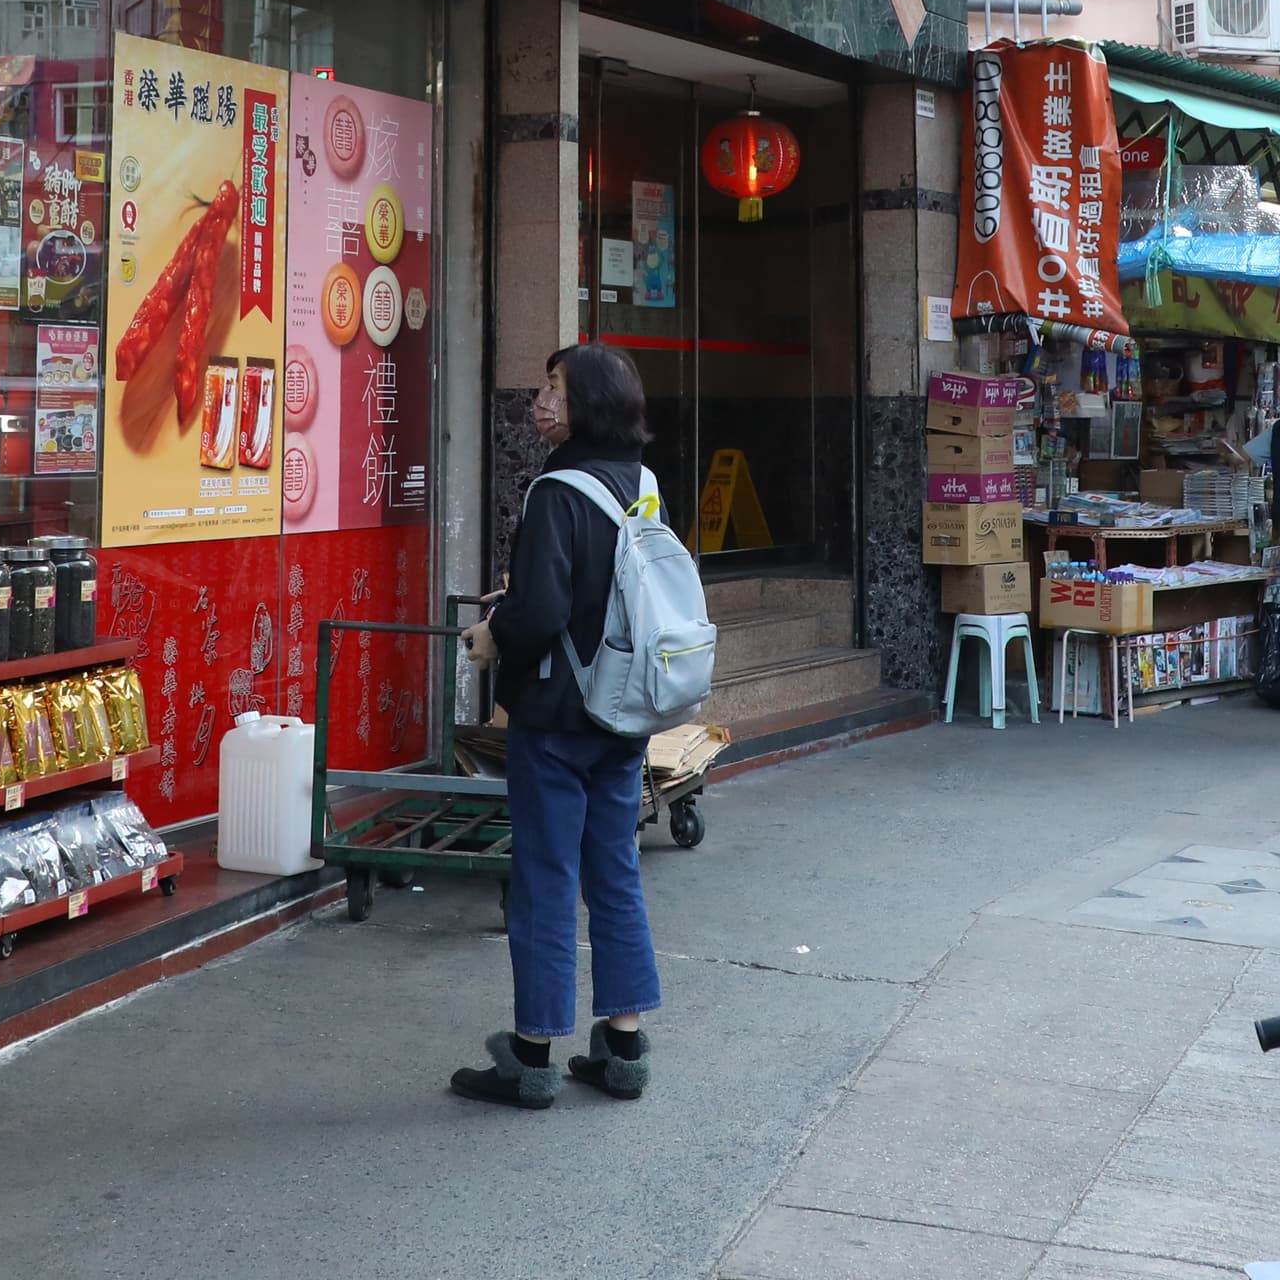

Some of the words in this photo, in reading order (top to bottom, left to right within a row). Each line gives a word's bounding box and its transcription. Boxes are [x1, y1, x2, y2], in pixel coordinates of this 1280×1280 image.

[123, 70, 134, 107] 香港
[250, 104, 268, 226] 最受歡迎
[378, 202, 390, 244] 榮華
[336, 282, 348, 324] 榮華
[942, 383, 969, 399] vita
[361, 352, 400, 508] 禮餅
[941, 478, 968, 494] vita
[991, 517, 1018, 529] MEVIUS
